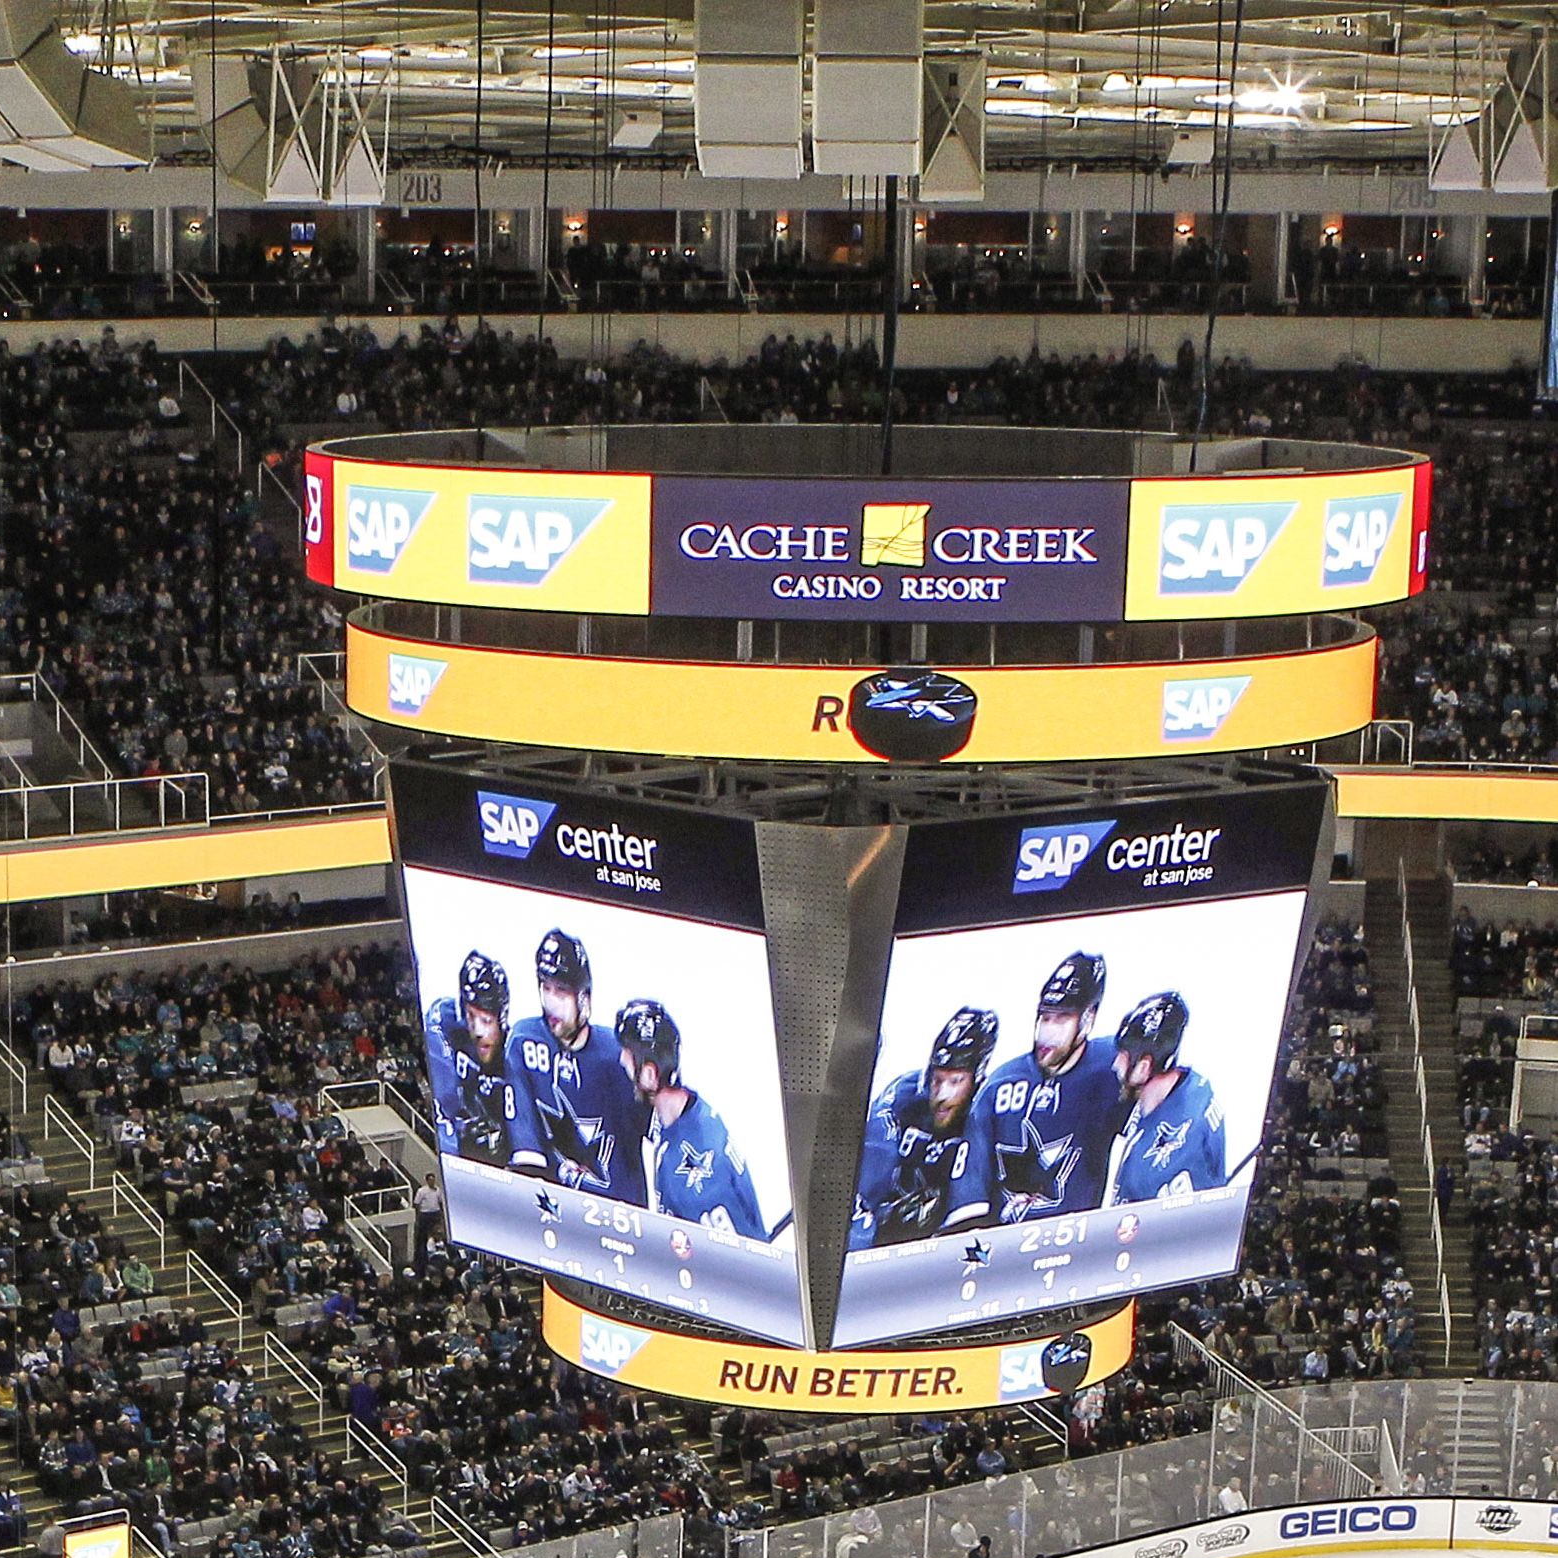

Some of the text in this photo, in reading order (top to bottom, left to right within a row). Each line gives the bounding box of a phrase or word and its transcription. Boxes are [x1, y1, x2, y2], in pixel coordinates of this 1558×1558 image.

[403, 173, 442, 202] 203
[348, 499, 411, 560] SAP
[469, 509, 573, 571] SAP
[680, 523, 1097, 563] CACHE CREEK
[1162, 517, 1267, 580] SAP
[1325, 509, 1388, 572] SAP
[772, 575, 1006, 601] CASINO RESORT
[389, 661, 431, 705] SAP
[1164, 687, 1229, 731] SAP
[480, 801, 657, 870] SAP center
[1016, 822, 1221, 882] SAP center
[596, 865, 662, 892] at san jose
[1143, 864, 1214, 887] at san jose
[522, 1039, 550, 1074] 88
[994, 1080, 1030, 1115] 88
[583, 1199, 643, 1238] 2:51
[1019, 1215, 1089, 1254] 2:51
[544, 1229, 558, 1250] 0
[612, 1254, 625, 1274] 1
[678, 1268, 692, 1289] 0
[1033, 1254, 1072, 1271] PERIOD
[1115, 1251, 1131, 1272] 0
[961, 1280, 977, 1301] 0
[1043, 1270, 1056, 1290] 1
[581, 1320, 630, 1368] SAP
[719, 1359, 964, 1398] RUN BETTER.
[1000, 1356, 1044, 1394] SA
[1280, 1505, 1418, 1540] GEICO
[1475, 1510, 1523, 1524] NHL
